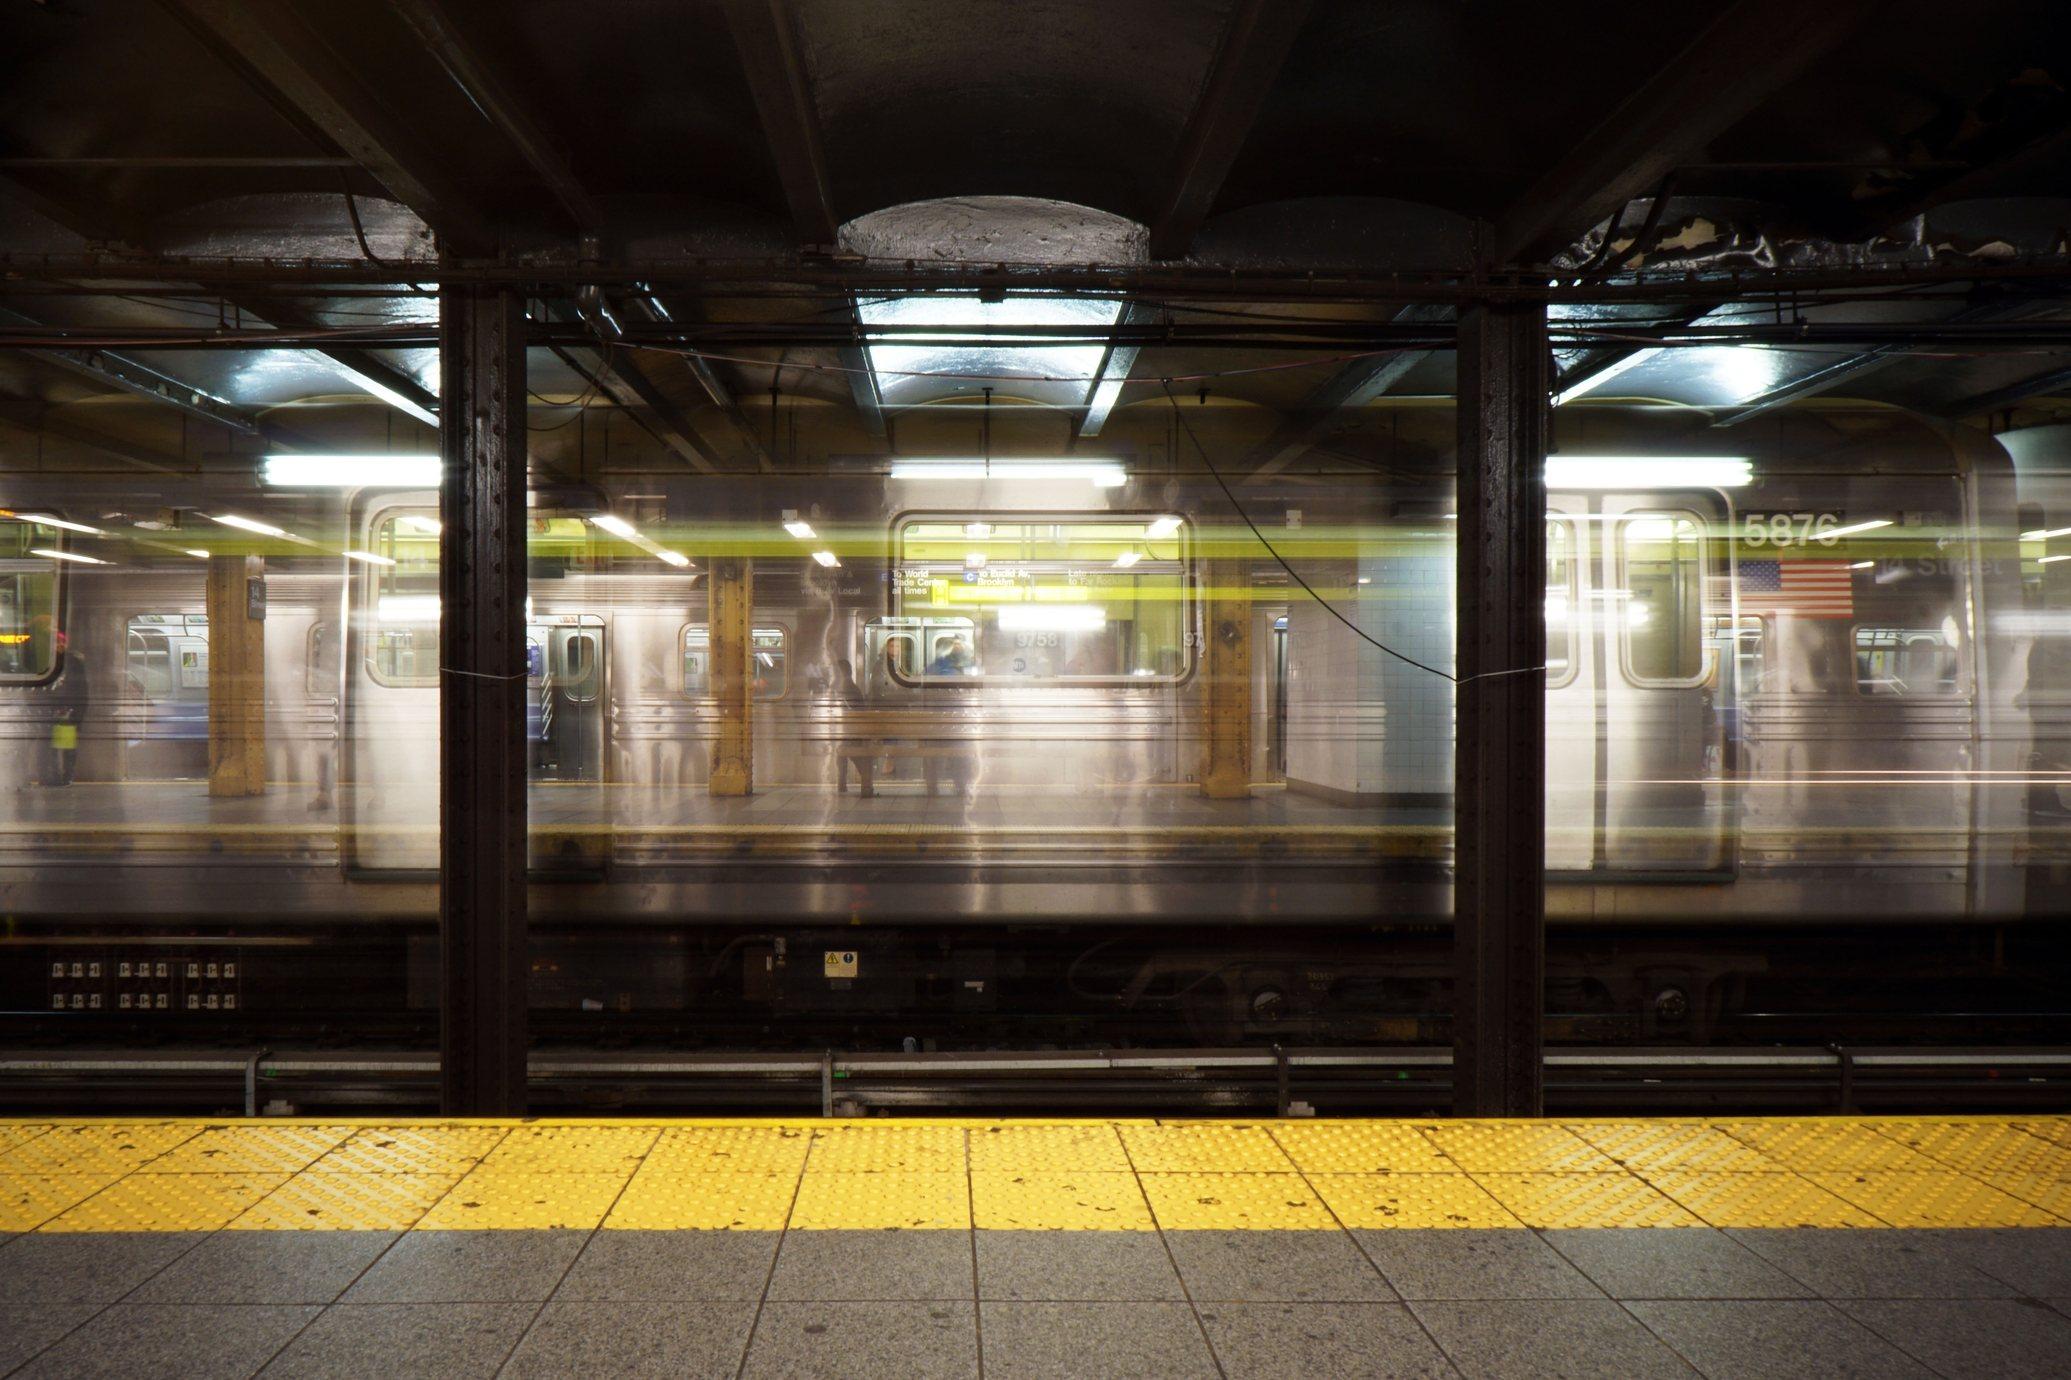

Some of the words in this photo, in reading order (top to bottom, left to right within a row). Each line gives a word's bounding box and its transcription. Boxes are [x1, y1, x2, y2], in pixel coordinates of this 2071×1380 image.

[1743, 513, 1840, 547] 5876
[1917, 553, 2004, 577] Street
[904, 569, 929, 578] World
[891, 577, 915, 587] Trade
[904, 586, 928, 595] times
[1016, 631, 1058, 647] 9758
